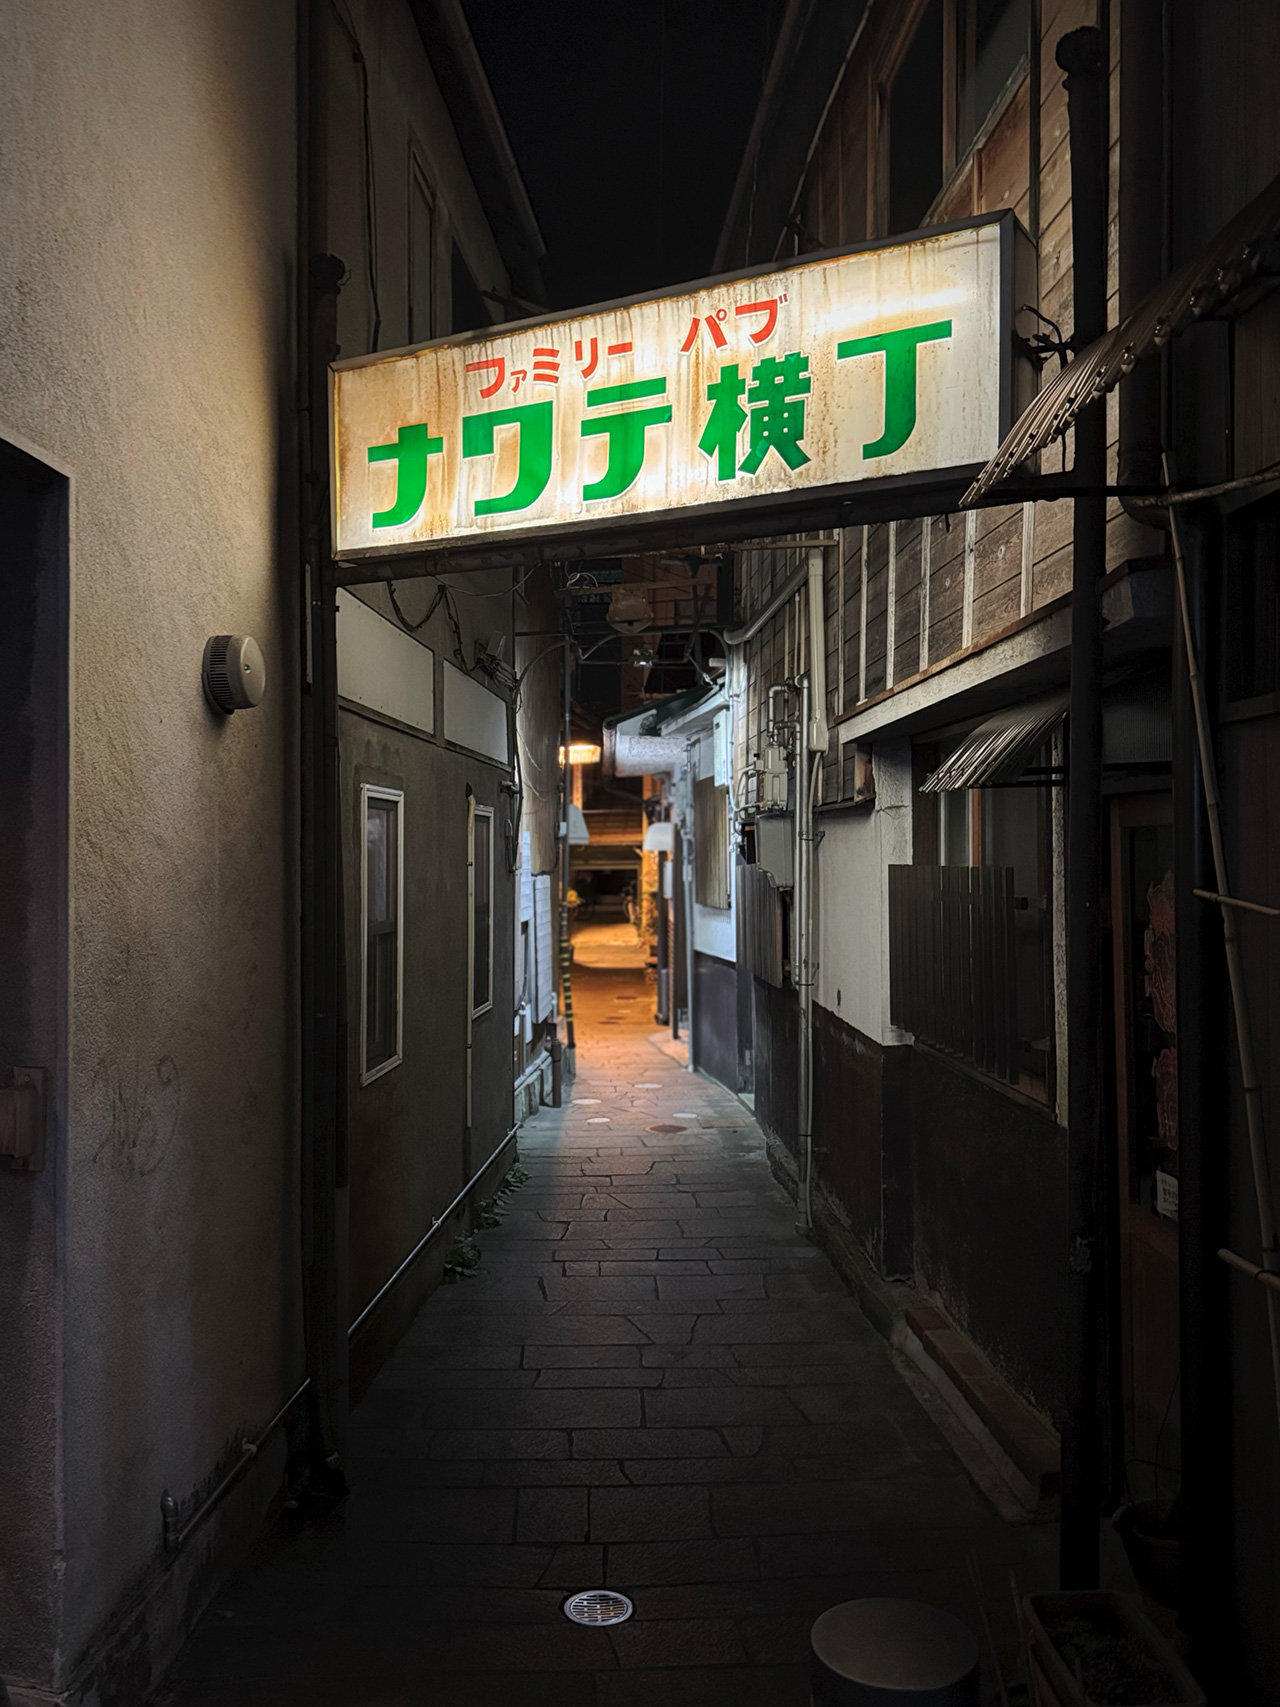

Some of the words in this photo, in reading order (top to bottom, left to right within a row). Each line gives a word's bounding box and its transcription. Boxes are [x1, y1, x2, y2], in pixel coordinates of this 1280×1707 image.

[367, 320, 953, 529] ナワテ横丁
[465, 338, 633, 399] ファミリー
[682, 294, 789, 352] パブ
